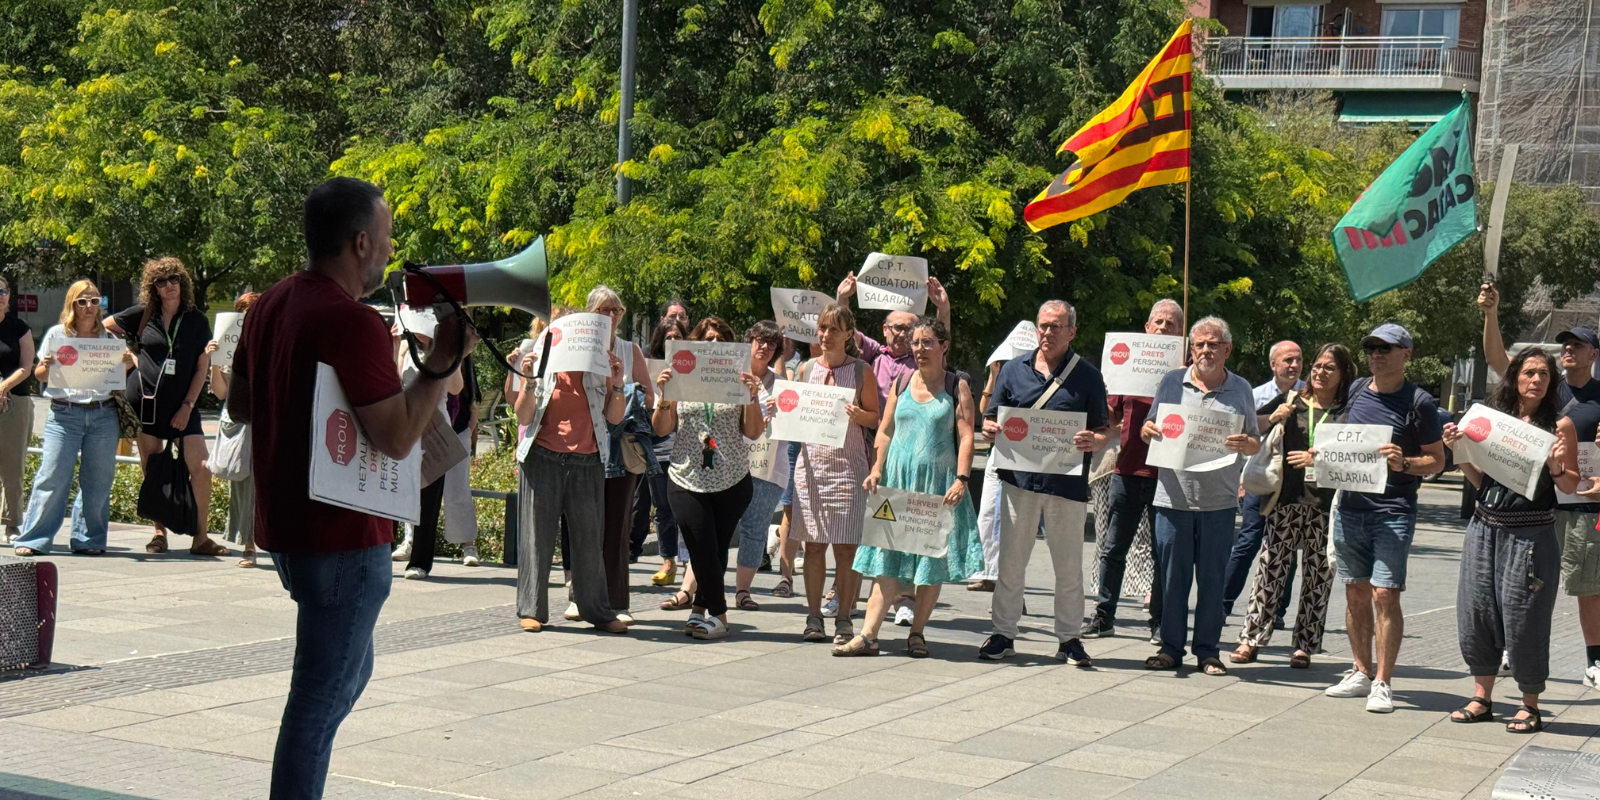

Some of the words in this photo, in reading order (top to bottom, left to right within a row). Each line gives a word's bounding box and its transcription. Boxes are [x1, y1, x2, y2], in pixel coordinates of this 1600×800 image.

[878, 260, 906, 272] C.P.T.
[865, 276, 919, 290] ROBATORI
[792, 294, 819, 305] C.P.T.
[864, 292, 912, 306] SALARIAL
[783, 310, 819, 321] ROBATO
[563, 320, 606, 329] RETALLADES
[788, 324, 818, 337] SALARIA
[568, 337, 603, 346] PERSONAL
[1132, 341, 1177, 350] RETALLADES
[568, 346, 602, 354] MUNICIPAL
[698, 349, 745, 357] RETALLADES
[1141, 350, 1165, 358] DRETS
[1133, 358, 1170, 367] PERSONAL
[701, 367, 740, 375] PERSONAL
[810, 399, 834, 408] DRETS
[801, 406, 838, 417] PERSONAL
[799, 415, 837, 426] MUNICIPAL
[1030, 416, 1079, 427] RETALLADES
[1187, 414, 1236, 428] RETALLADES
[1041, 427, 1066, 435] DRETS
[1197, 425, 1223, 435] DRETS
[1495, 421, 1545, 448] RETALLADES
[336, 411, 348, 465] PROU!
[1033, 435, 1073, 445] PERSONAL
[1336, 431, 1363, 443] C.P.T.
[748, 443, 771, 453] OBAT
[1032, 444, 1072, 453] MUNICIPAL
[1187, 442, 1224, 454] MUNICIPAL
[1501, 435, 1528, 452] DRETS
[370, 444, 378, 473] DRE
[1323, 451, 1377, 463] ROBATORI
[1490, 441, 1531, 465] PERSONAL
[750, 460, 768, 469] ALAR
[1487, 450, 1528, 474] MUNICIPAL
[380, 452, 388, 491] PERS
[1328, 471, 1375, 484] SALARIAL
[907, 498, 939, 508] SERVEIS
[898, 514, 943, 528] MUNICIPALS
[916, 526, 934, 536] RISC
